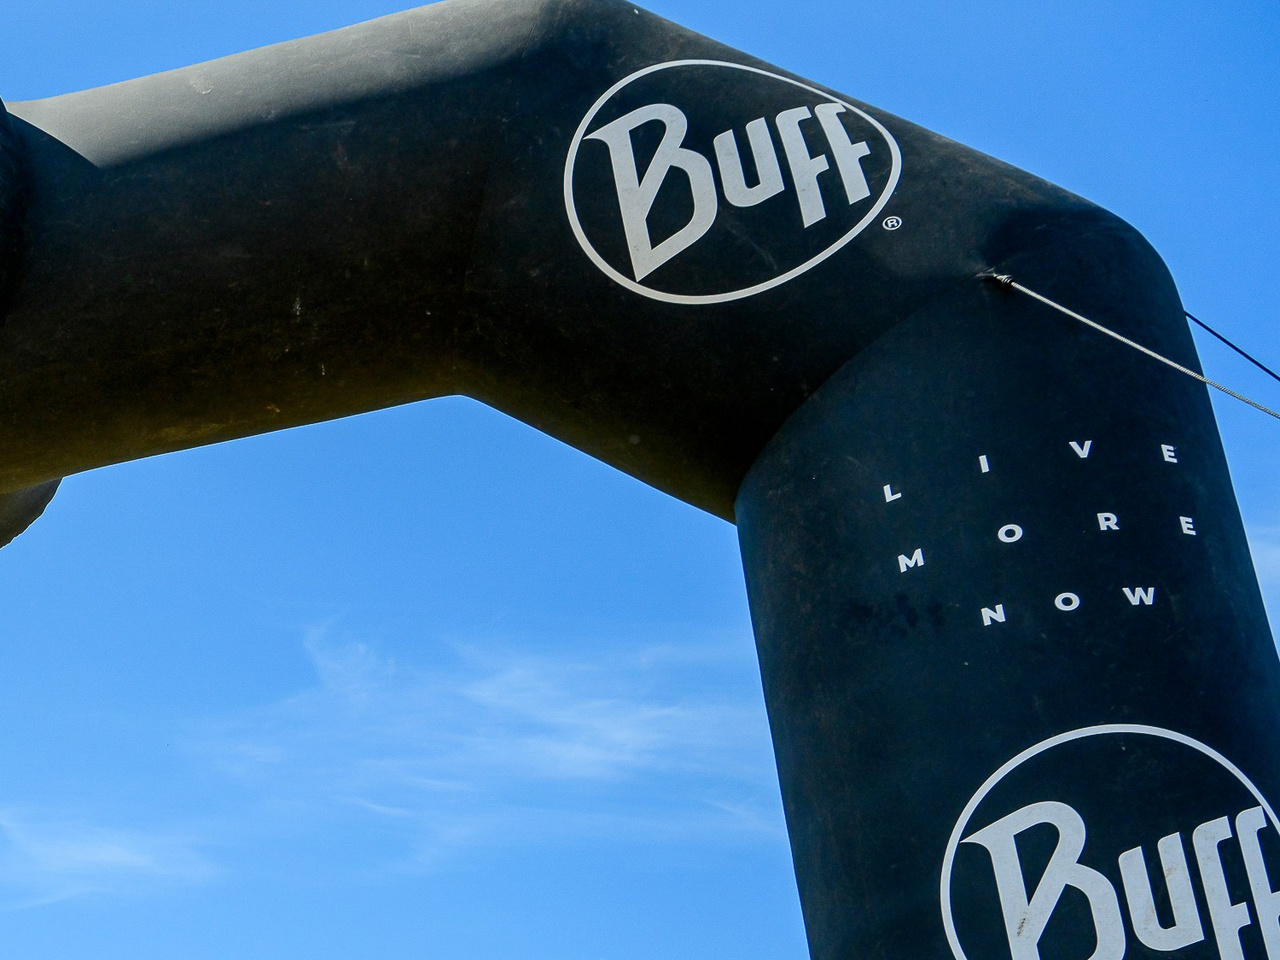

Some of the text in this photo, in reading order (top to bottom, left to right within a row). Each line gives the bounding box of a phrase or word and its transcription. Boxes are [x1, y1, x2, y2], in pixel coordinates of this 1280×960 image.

[883, 440, 1178, 503] LIVE
[897, 512, 1197, 573] MORE
[980, 587, 1155, 626] NOW
